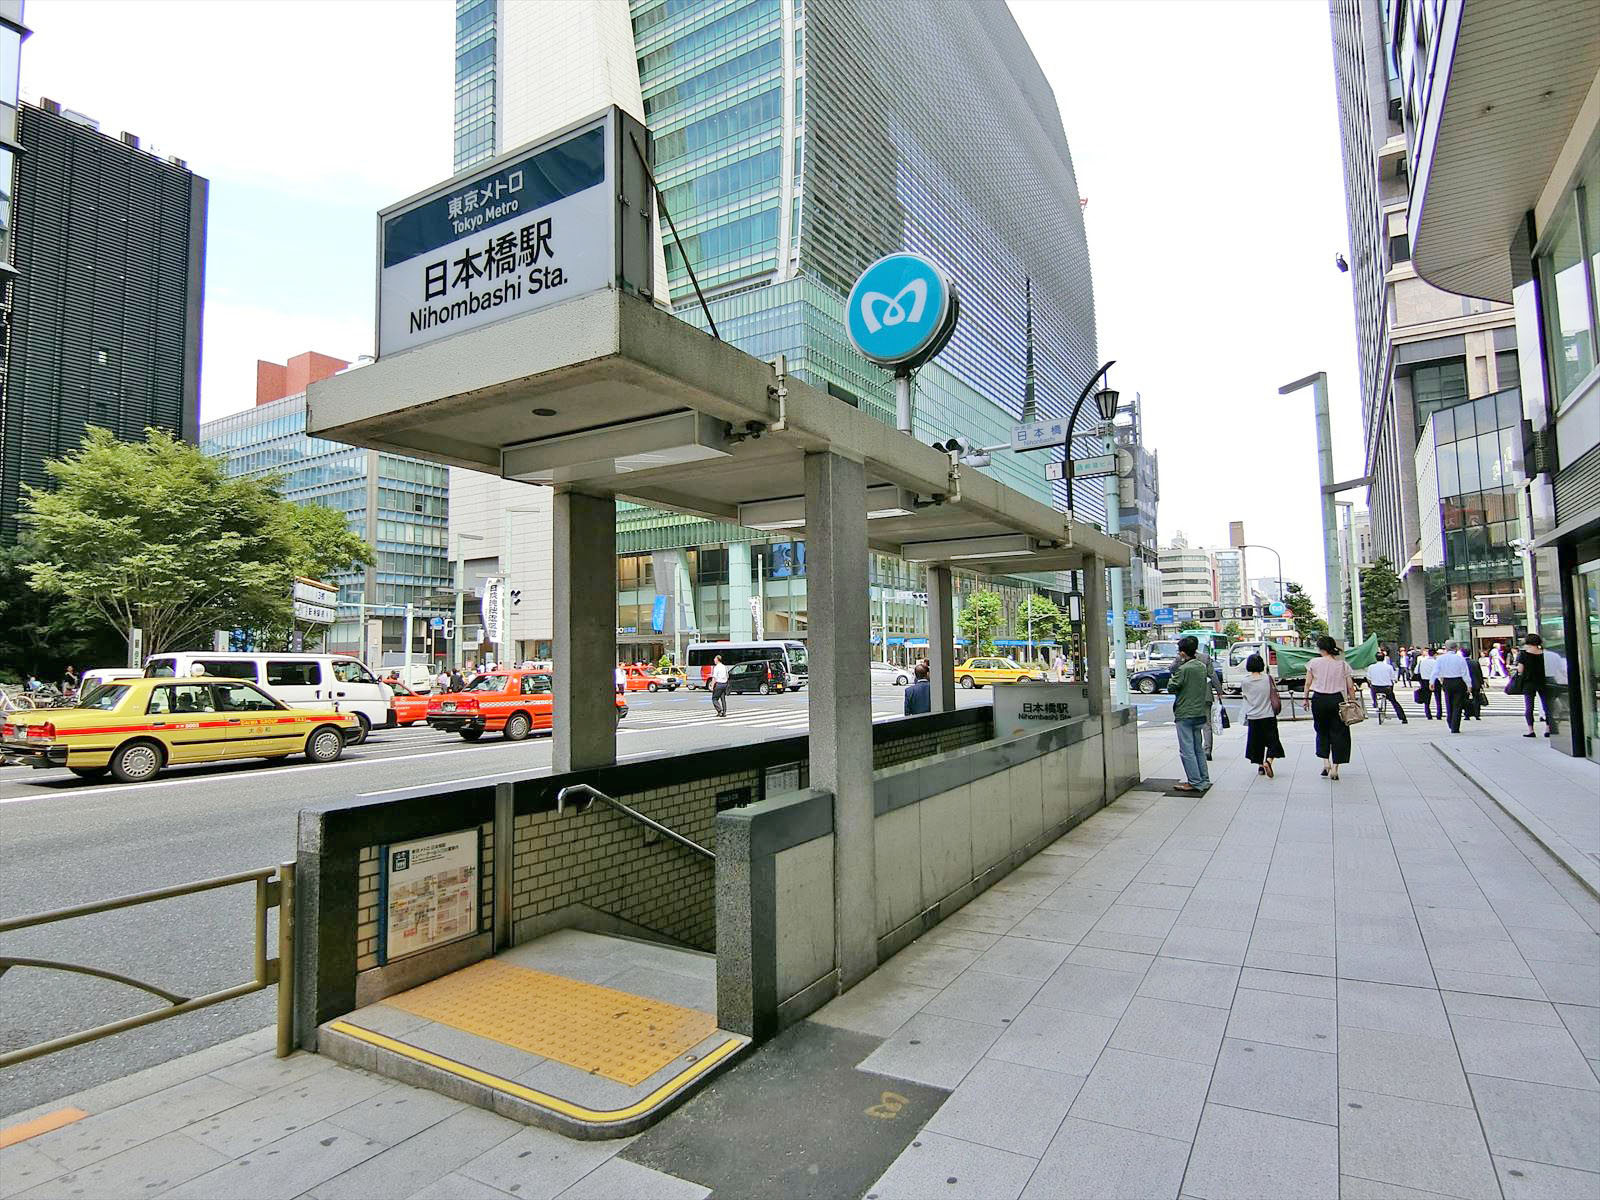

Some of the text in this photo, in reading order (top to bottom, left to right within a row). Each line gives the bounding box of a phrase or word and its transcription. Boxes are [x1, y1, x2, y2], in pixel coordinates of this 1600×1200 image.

[447, 170, 524, 219] 東京メトロ
[452, 199, 519, 235] Tokyo Metro
[424, 217, 555, 302] 日本橋駅
[409, 264, 569, 334] Nihombashi Sta.
[1018, 425, 1062, 441] 日本橋
[1023, 702, 1070, 714] 日本橋駅
